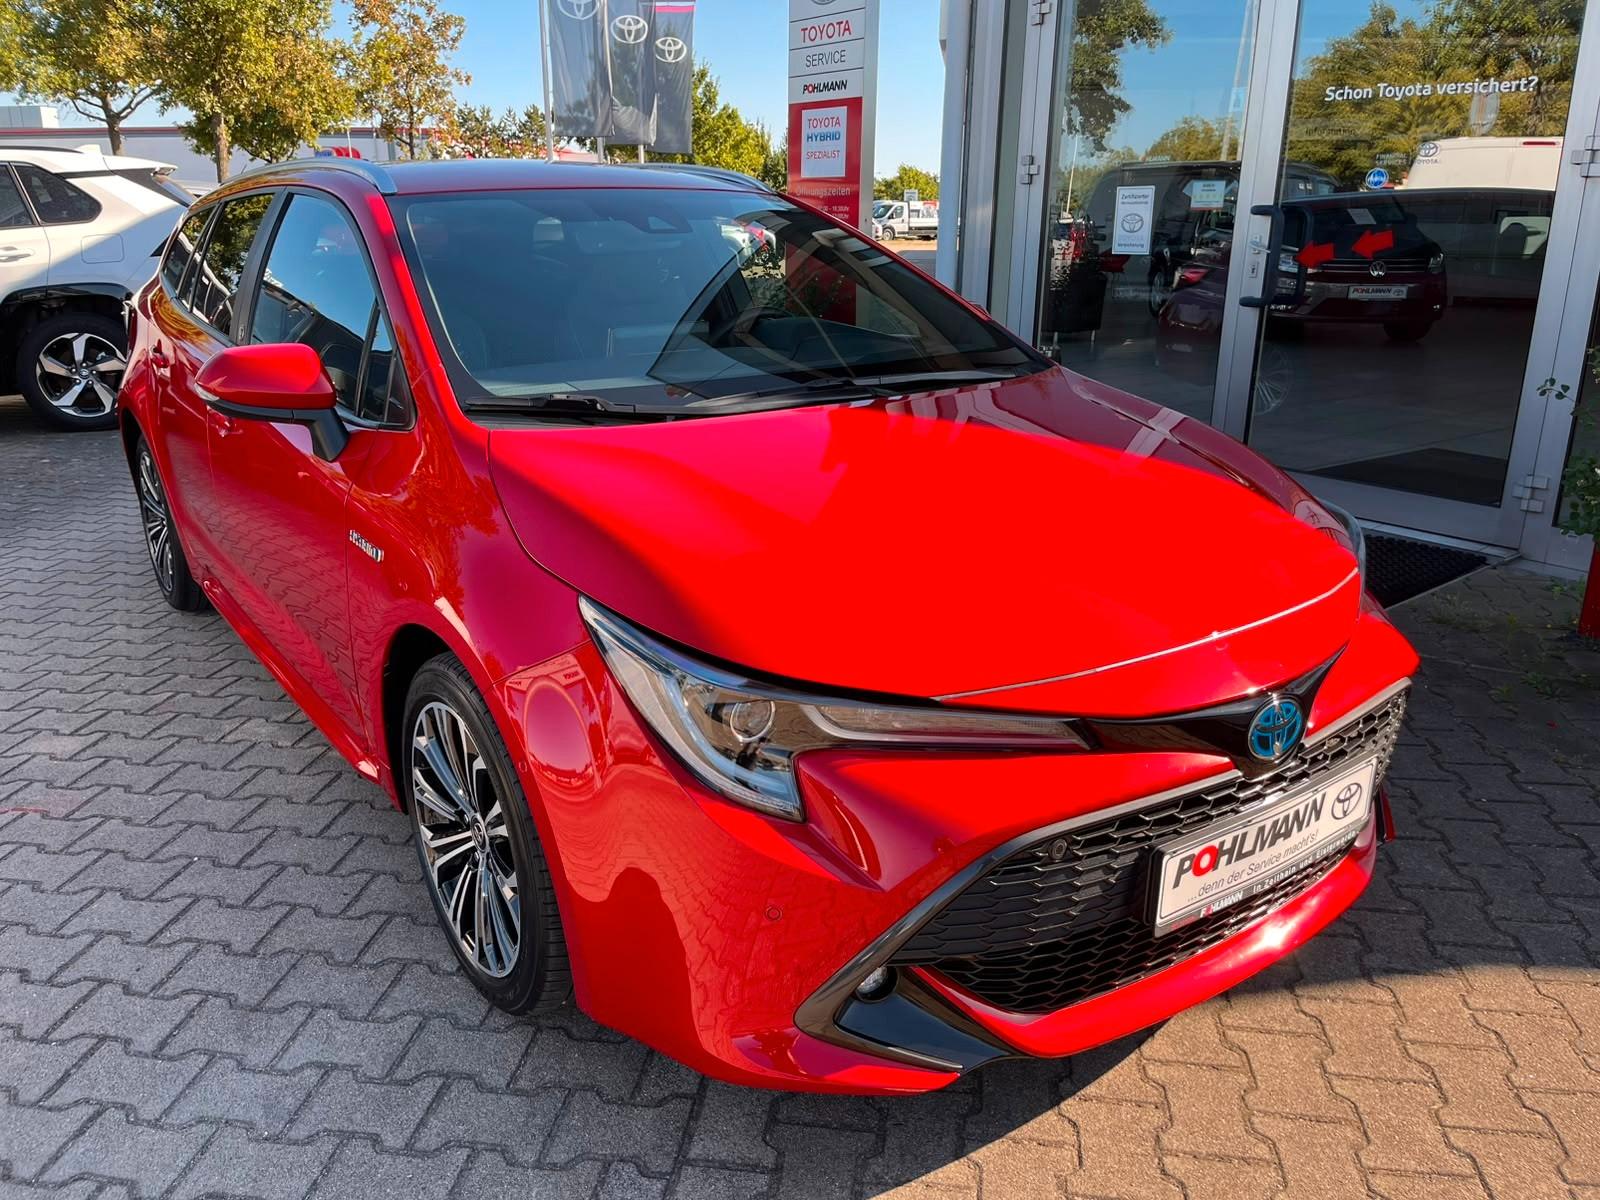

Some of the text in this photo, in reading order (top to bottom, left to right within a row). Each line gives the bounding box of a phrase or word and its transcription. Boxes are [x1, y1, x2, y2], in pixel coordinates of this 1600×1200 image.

[800, 19, 852, 43] TOYOTA
[805, 49, 847, 68] SERVICE
[802, 79, 848, 95] POHLMANN
[1324, 75, 1539, 101] Schon Toyota versichert?
[807, 116, 841, 129] TOYOTA
[806, 131, 841, 142] HYBRID
[806, 150, 840, 160] SPEZIALIST
[1172, 792, 1326, 889] POHLMANN
[1227, 869, 1245, 884] der
[1246, 853, 1282, 876] Service
[1283, 829, 1319, 858] macht's!
[1299, 855, 1313, 869] und
